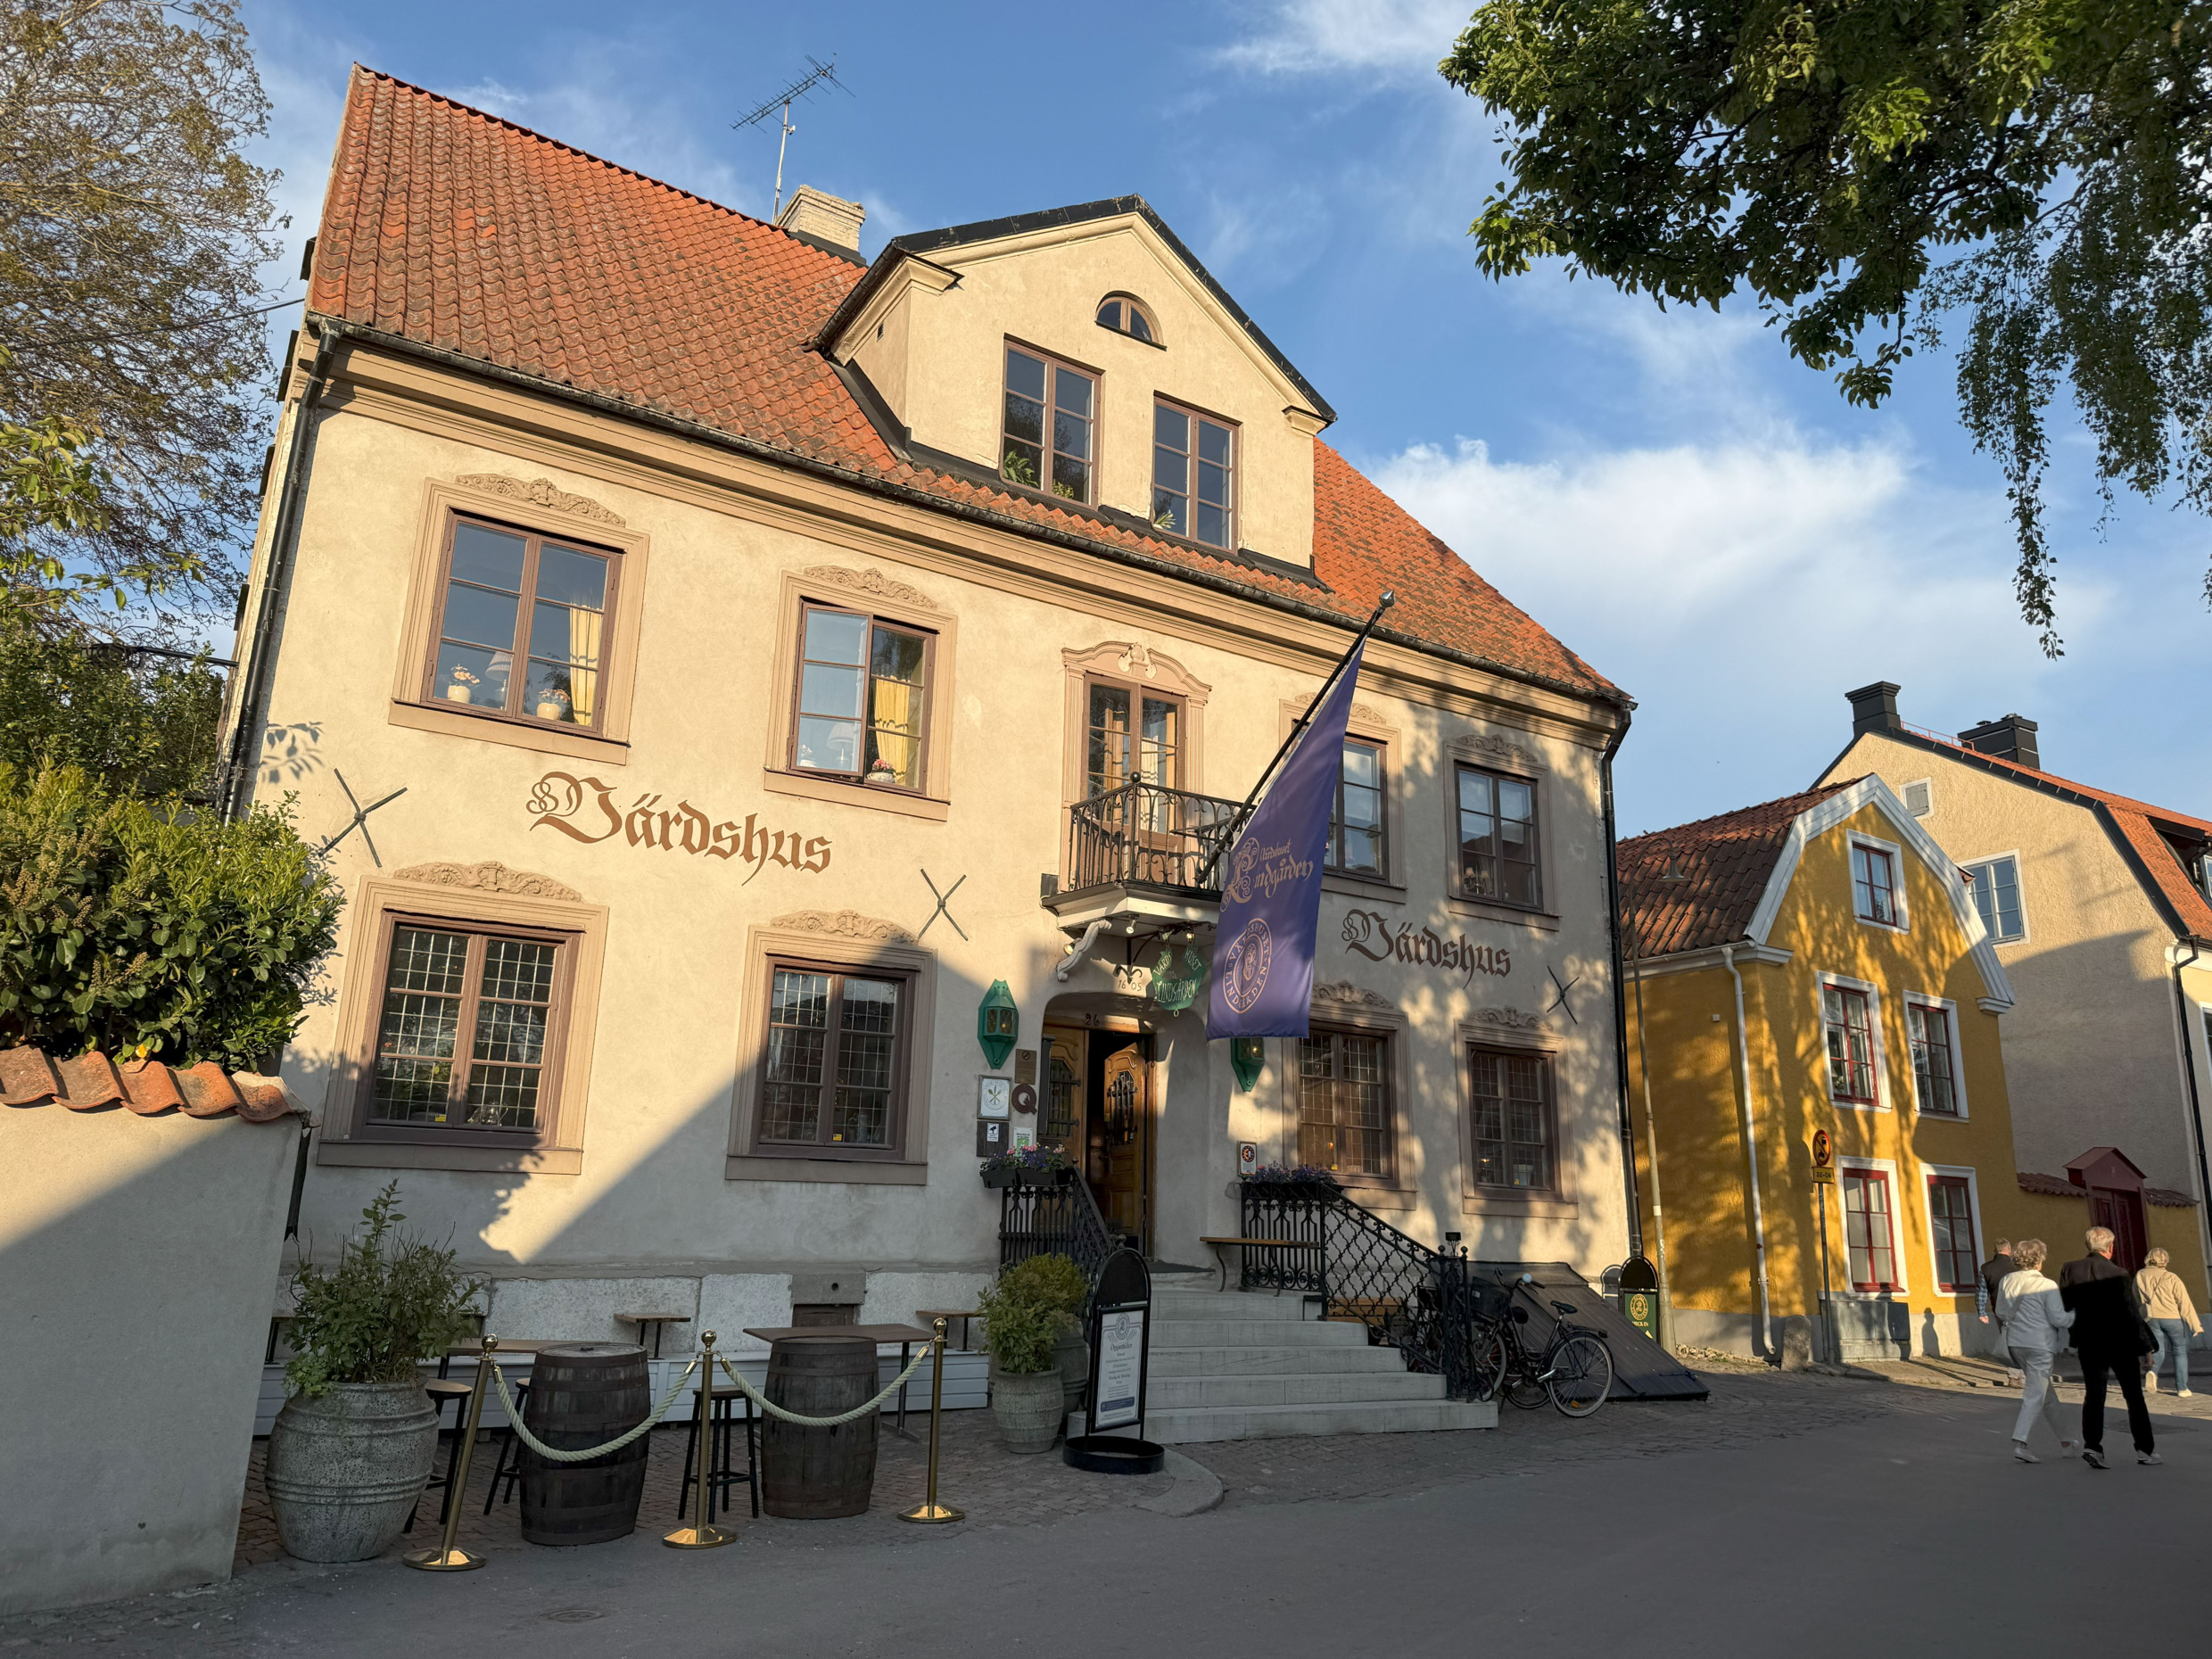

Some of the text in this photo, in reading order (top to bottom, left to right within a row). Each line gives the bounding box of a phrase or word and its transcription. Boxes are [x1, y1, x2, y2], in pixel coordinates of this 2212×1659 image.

[525, 771, 833, 887] Värdshus
[1184, 948, 1202, 971] HUSET
[1341, 908, 1511, 991] Värdshus
[1085, 1012, 1101, 1027] 26
